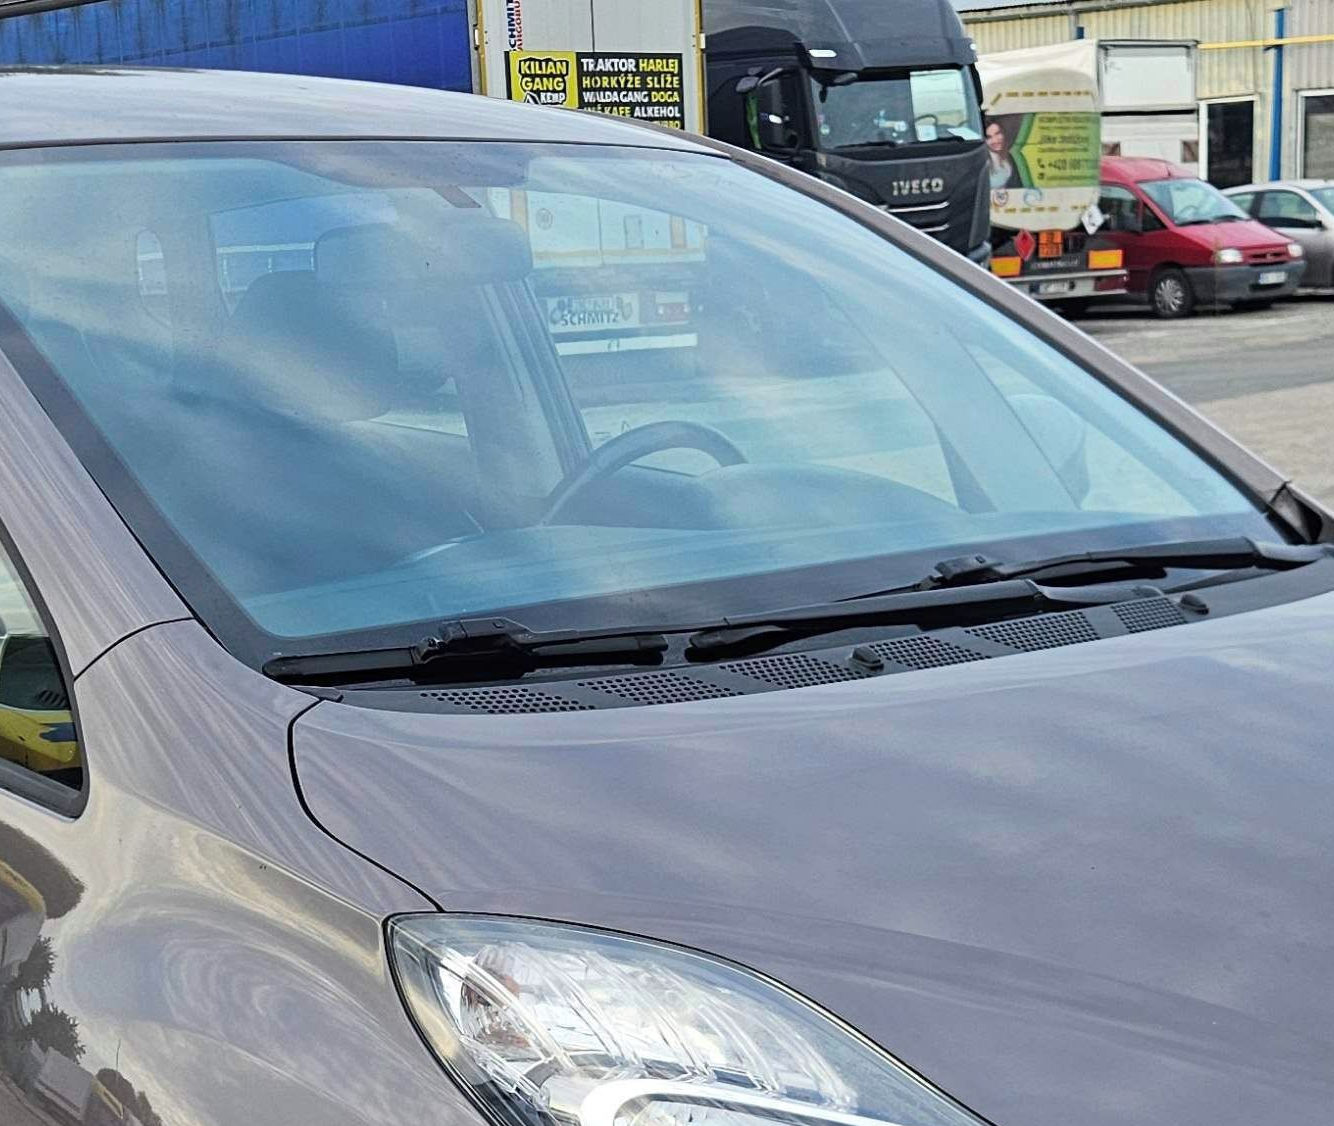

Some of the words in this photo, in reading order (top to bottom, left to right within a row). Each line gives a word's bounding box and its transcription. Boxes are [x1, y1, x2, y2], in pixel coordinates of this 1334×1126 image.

[506, 0, 517, 51] CHMIT
[520, 60, 567, 75] KILIAN
[581, 58, 636, 72] TRAKTOR
[639, 59, 679, 74] HARLEJ
[521, 77, 565, 91] GANG
[582, 73, 642, 88] HORKÝŽE
[646, 73, 680, 88] SLÍŽE
[651, 92, 680, 103] DOGA
[633, 106, 681, 117] ALKEHOL
[892, 178, 944, 196] IVECO
[560, 311, 619, 326] SCHMITZ
